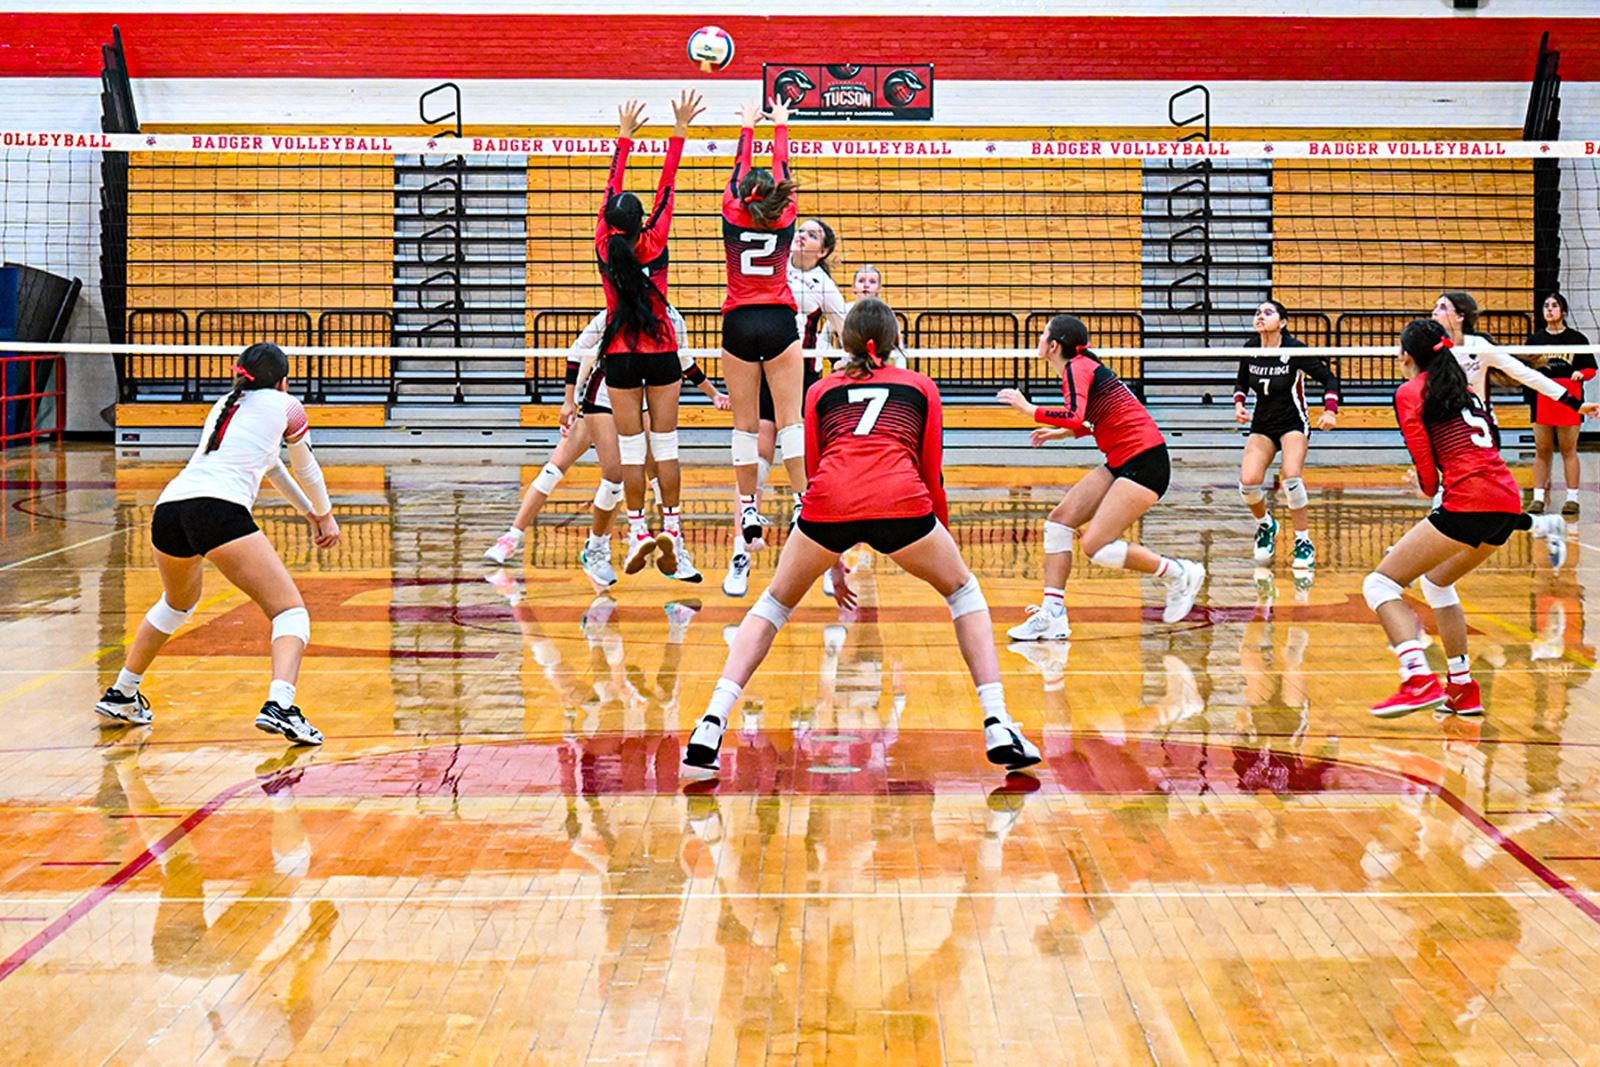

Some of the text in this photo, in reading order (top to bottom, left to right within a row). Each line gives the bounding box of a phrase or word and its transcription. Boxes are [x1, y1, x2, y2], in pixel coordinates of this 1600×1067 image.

[823, 91, 872, 108] TUCSON
[0, 132, 111, 148] OLLEYBALL
[192, 135, 393, 151] BADGER VOLLEYBALL
[473, 138, 543, 152] BADGER
[753, 141, 823, 155] BAGER
[832, 141, 952, 155] VOLLEYBALL
[1032, 142, 1230, 156] BADGER VOLLEYBALL
[1309, 142, 1506, 155] BADGER VOLLEYBALL
[1585, 142, 1600, 155] B
[739, 232, 778, 276] 2
[1258, 378, 1270, 396] 7
[847, 387, 889, 436] 7
